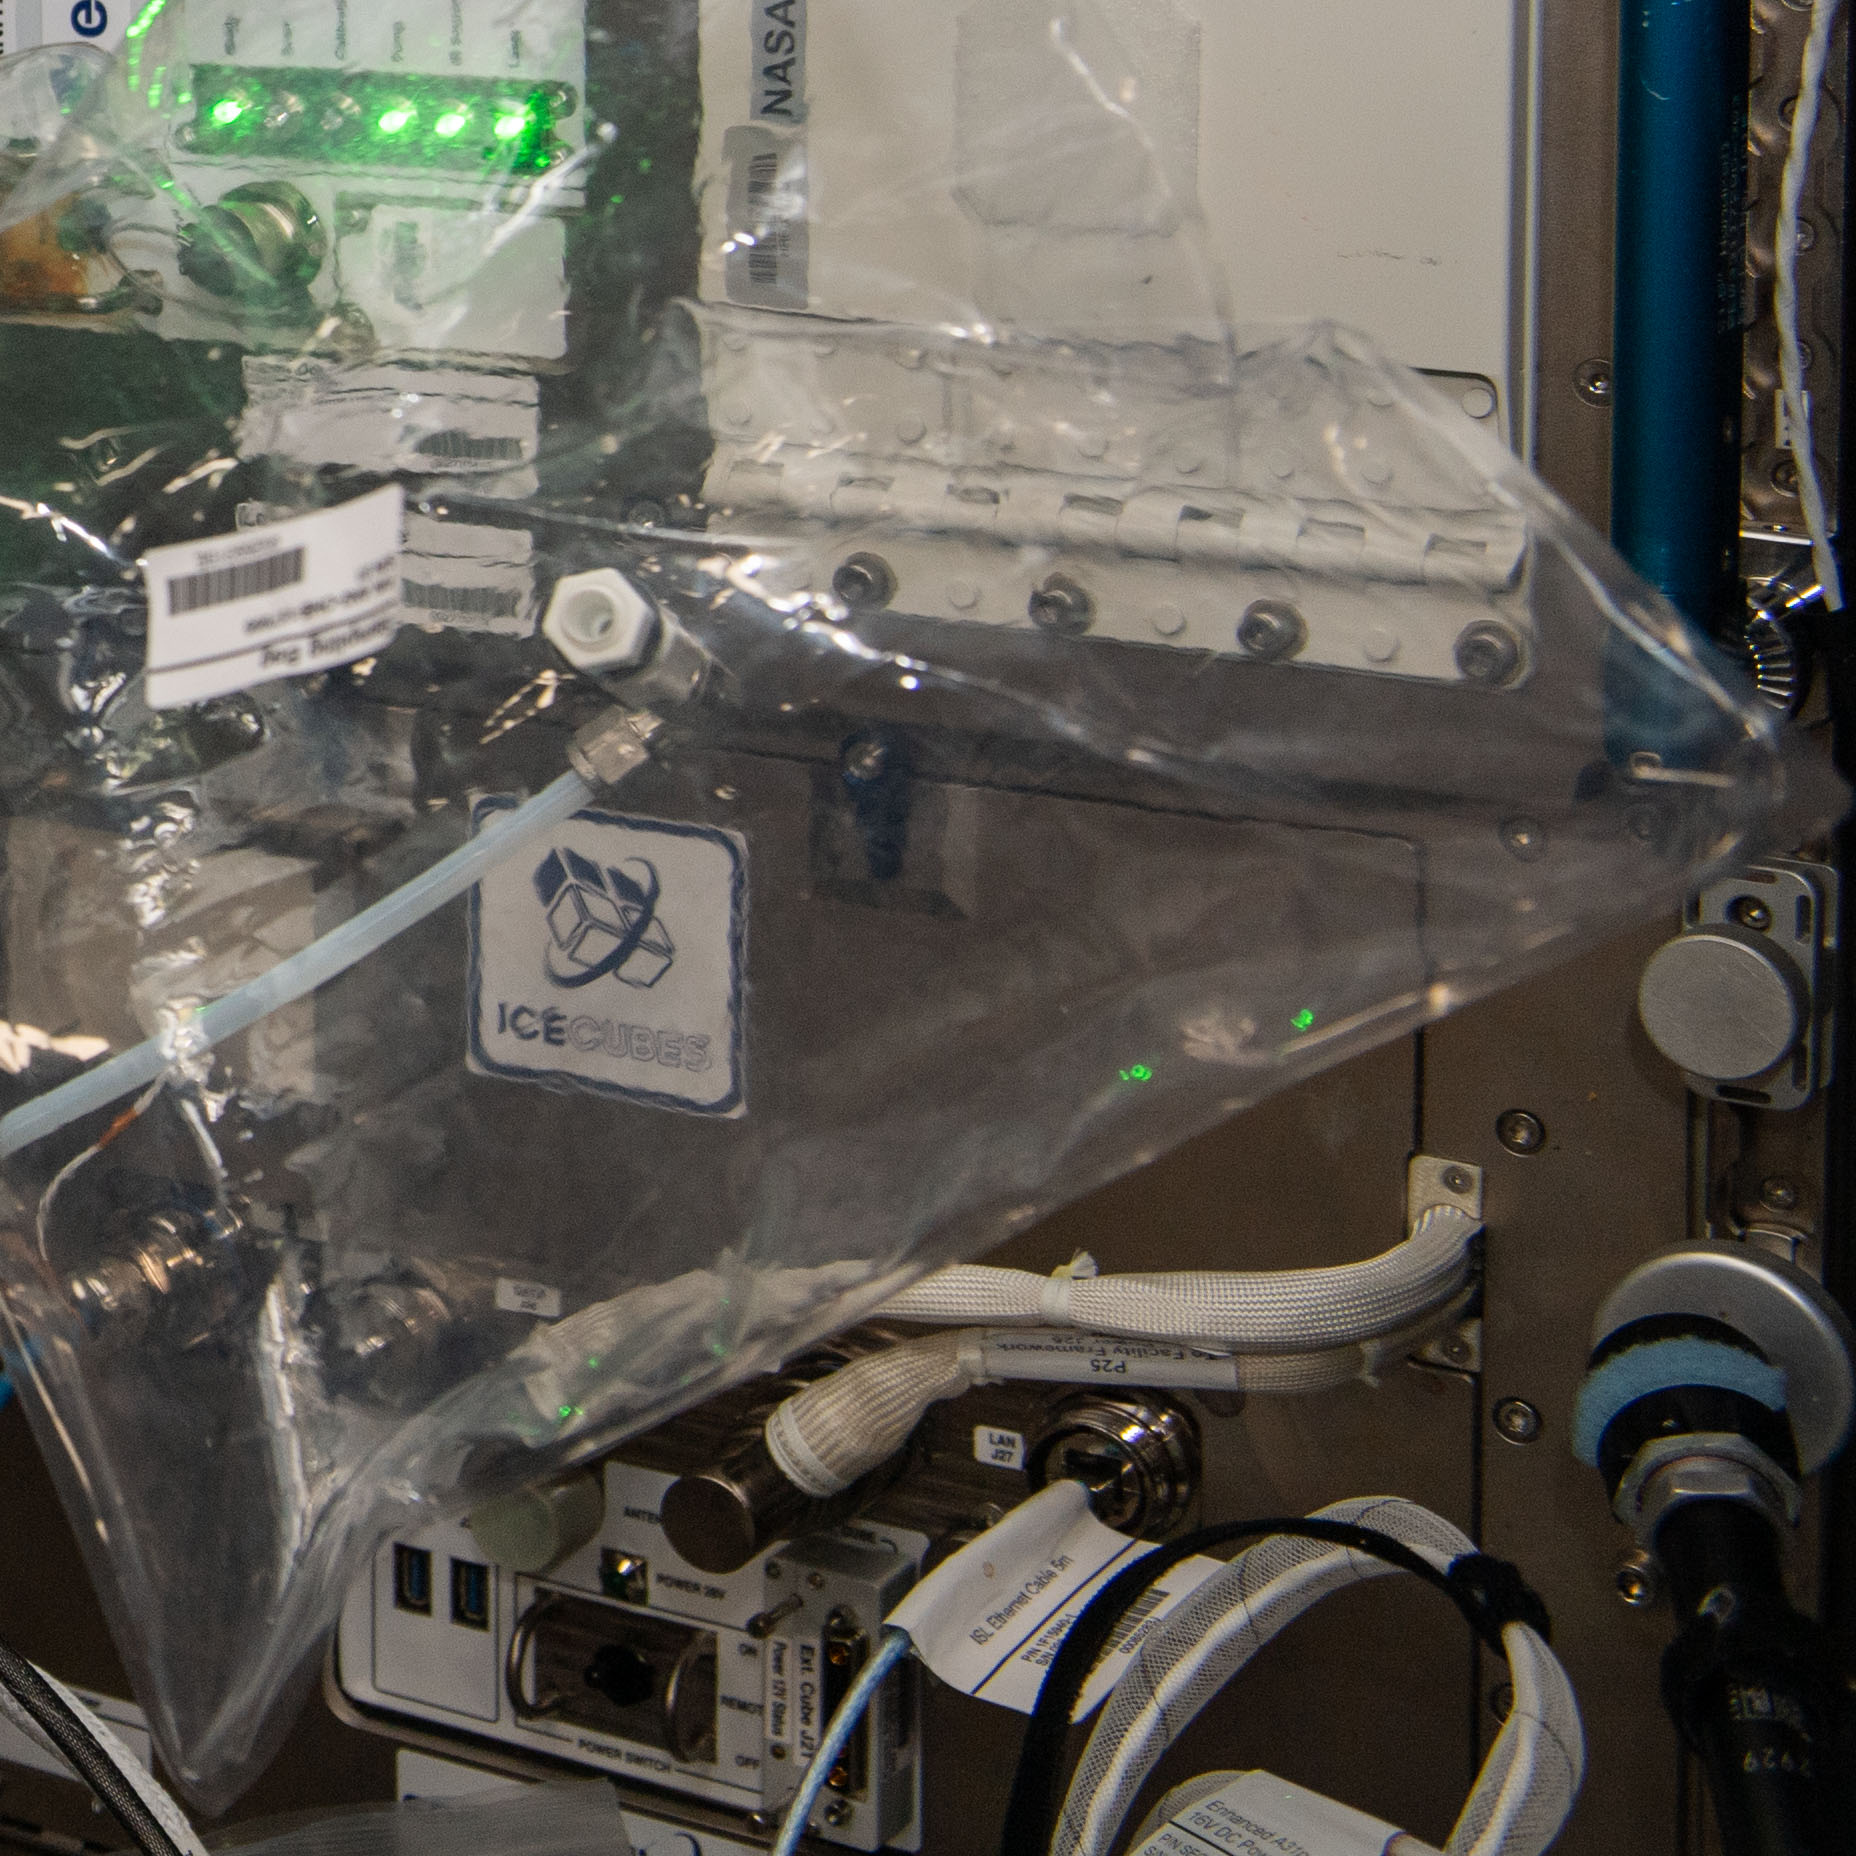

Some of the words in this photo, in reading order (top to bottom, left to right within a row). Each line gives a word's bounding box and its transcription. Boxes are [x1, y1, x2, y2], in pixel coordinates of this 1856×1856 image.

[995, 1343, 1106, 1358] Framework
[1113, 1346, 1185, 1360] Facility
[1090, 1359, 1127, 1374] P25
[989, 1433, 1015, 1448] LAN
[656, 1573, 700, 1592] POWER
[986, 1590, 1031, 1631] Ethernet
[1024, 1568, 1058, 1596] Cable
[1053, 1554, 1075, 1576] 5m
[1188, 1811, 1218, 1830] 16V
[1213, 1825, 1243, 1845] DC
[1205, 1800, 1276, 1840] Enhanced
